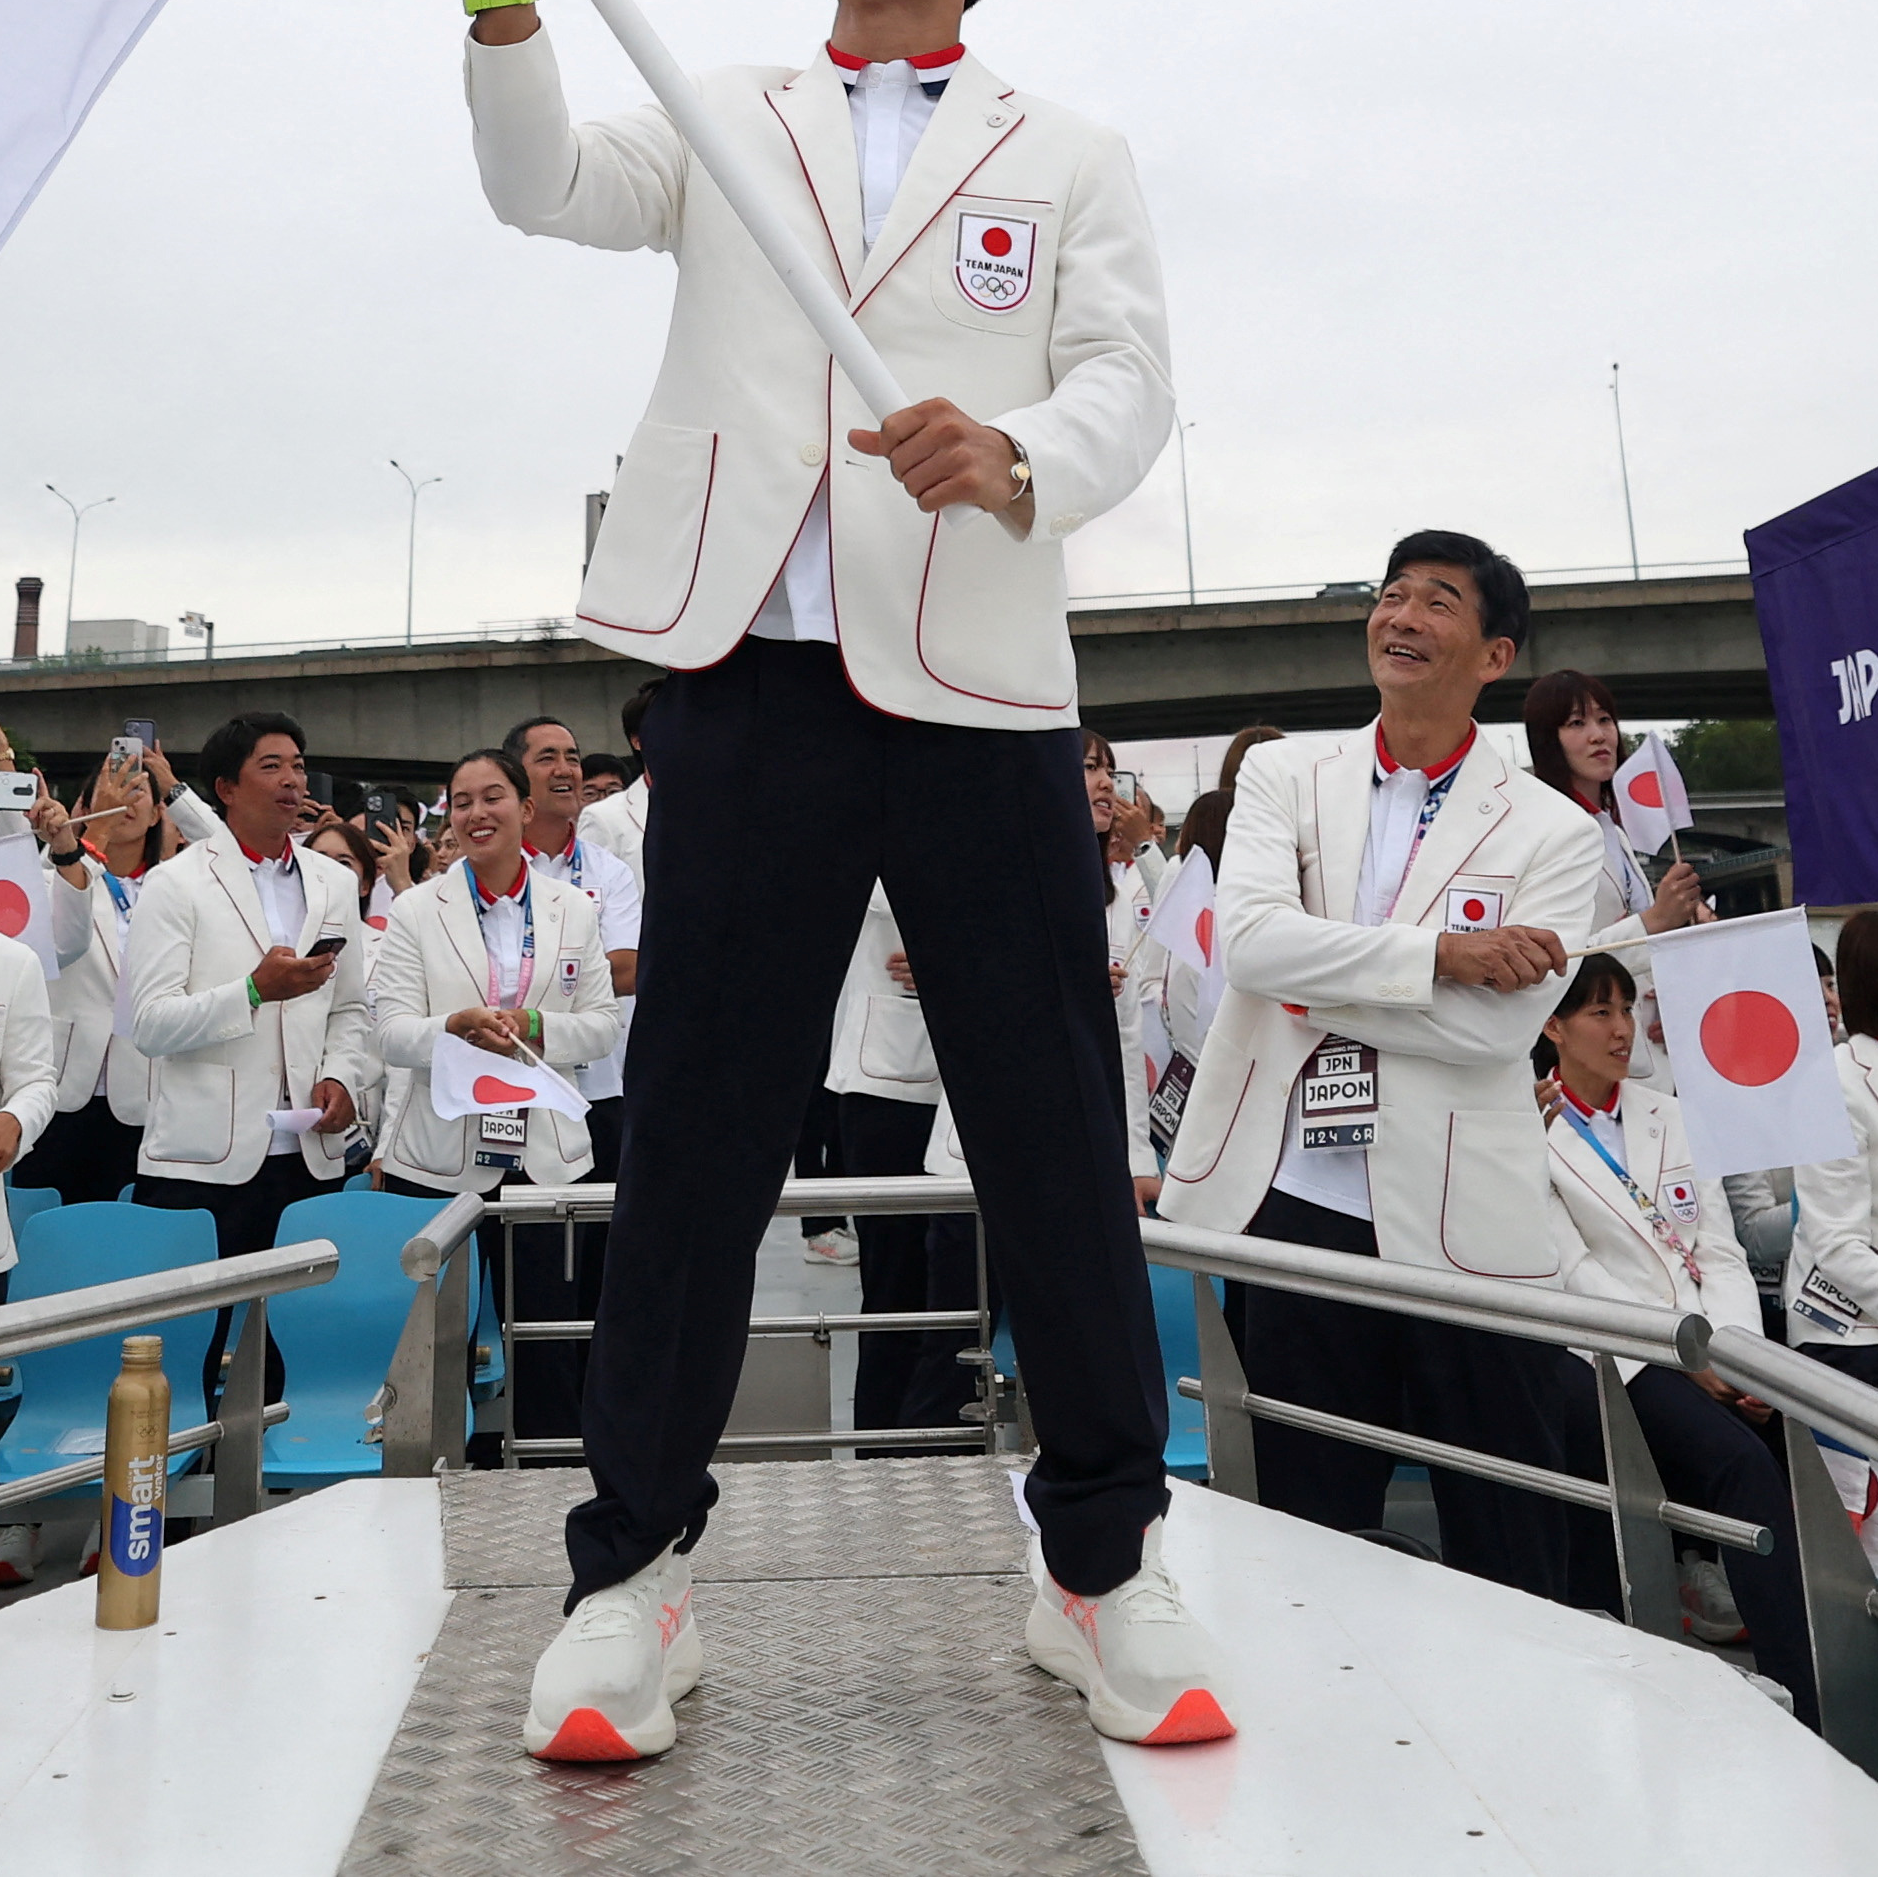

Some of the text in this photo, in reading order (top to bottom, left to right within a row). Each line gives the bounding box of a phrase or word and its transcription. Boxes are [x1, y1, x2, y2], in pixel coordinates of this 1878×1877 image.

[965, 258, 1024, 278] TEAM JAPAN
[1451, 924, 1472, 932] TEAM
[1325, 1056, 1353, 1072] JPN
[1309, 1080, 1371, 1103] JAPON
[1152, 1099, 1178, 1130] JAPON
[484, 1120, 523, 1137] JAPON
[1306, 1129, 1338, 1144] H24
[154, 1453, 166, 1501] water
[127, 1454, 155, 1560] smart
